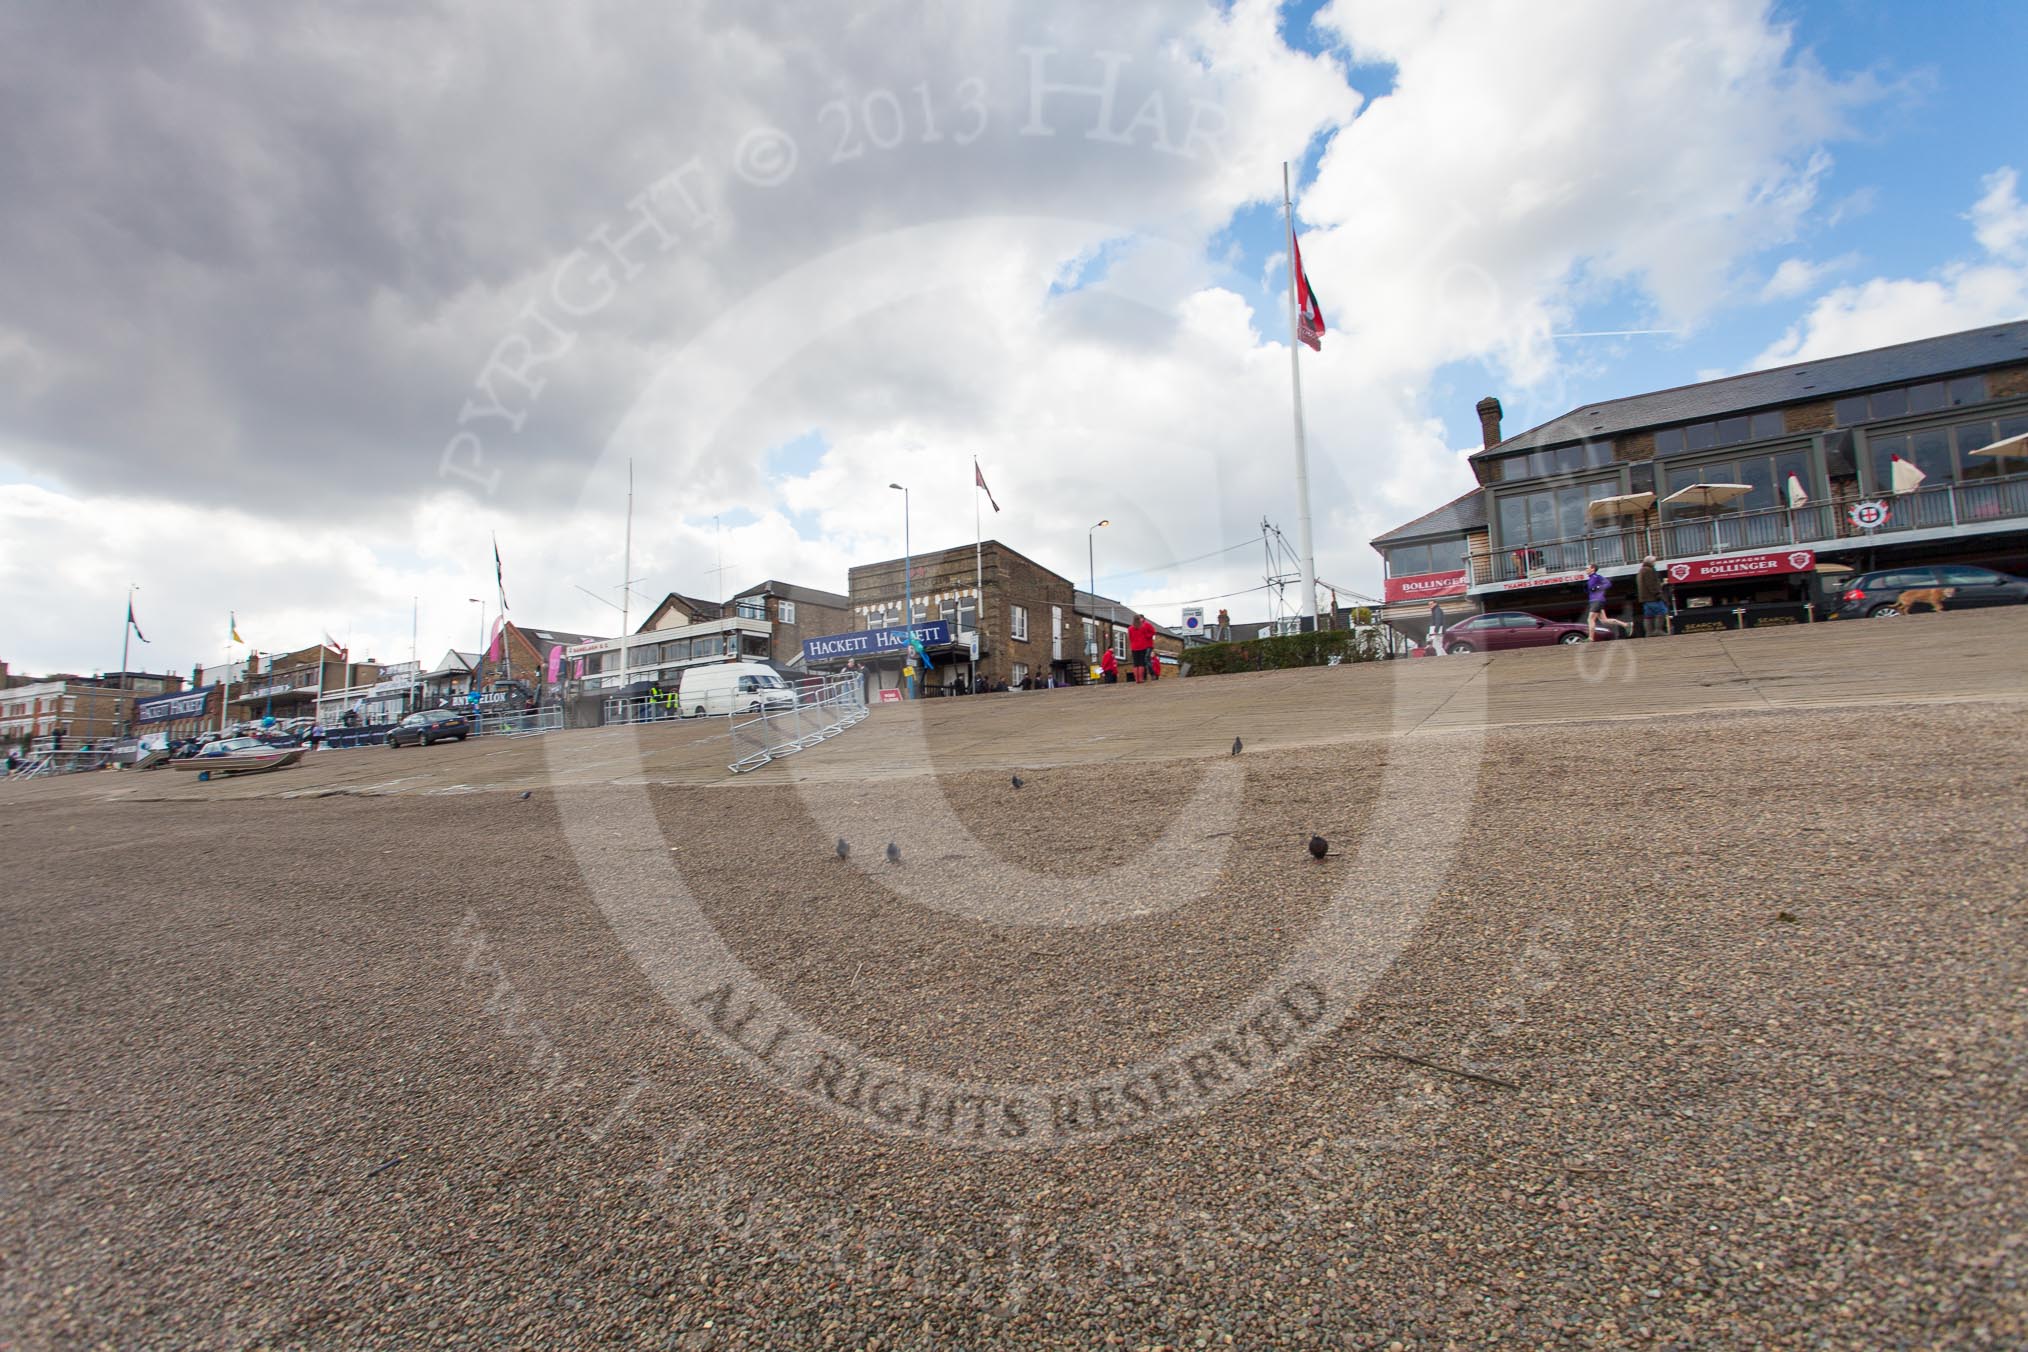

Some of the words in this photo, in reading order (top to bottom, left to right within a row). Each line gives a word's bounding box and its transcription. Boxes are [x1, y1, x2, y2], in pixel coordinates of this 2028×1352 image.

[1700, 560, 1778, 575] BOLLINGER
[1402, 576, 1470, 591] BOLLINGER
[1503, 579, 1533, 589] THAMES
[809, 636, 868, 656] HACKETT
[876, 627, 940, 647] HACETT
[478, 691, 506, 704] ELLON
